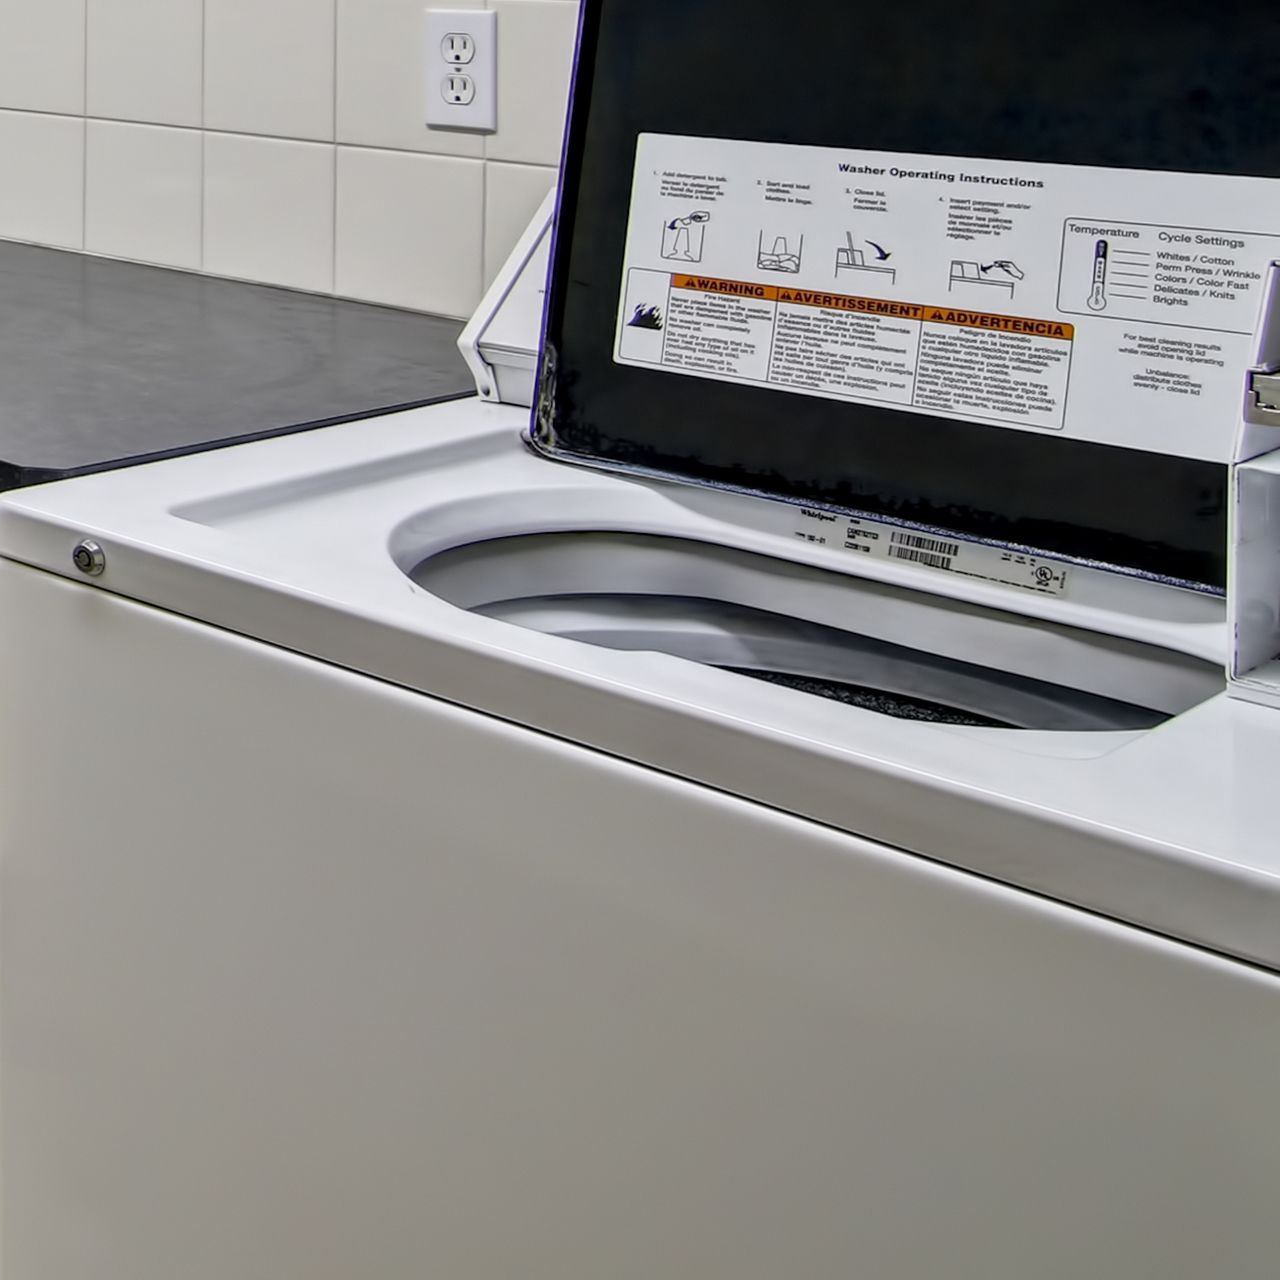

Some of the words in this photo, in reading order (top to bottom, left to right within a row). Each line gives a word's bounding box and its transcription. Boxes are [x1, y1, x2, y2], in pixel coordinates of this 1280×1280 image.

[838, 163, 886, 175] Washer
[889, 167, 955, 182] Operating
[959, 172, 1043, 188] Instructions
[1068, 223, 1139, 238] Temperature
[1158, 231, 1192, 243] Cycle
[1194, 234, 1244, 249] Settings
[1156, 251, 1190, 261] Whites
[1192, 254, 1198, 262] /
[1199, 255, 1234, 265] Cotton
[1155, 261, 1182, 272] Perm
[1184, 264, 1213, 275] Press
[1222, 268, 1260, 279] Wrinkle
[697, 279, 763, 296] WARNING
[1154, 272, 1187, 283] Colors
[1188, 276, 1194, 284] /
[1195, 277, 1224, 287] Color
[1226, 280, 1249, 289] Fast
[1152, 294, 1188, 306] Brights
[1153, 283, 1199, 296] Delicates
[1209, 289, 1235, 300] Knits
[793, 292, 920, 316] AVERTISSEMENT
[945, 311, 1063, 336] ADVERTENCIA
[1123, 332, 1137, 340] For
[1138, 335, 1156, 343] best
[1157, 338, 1192, 348] cleaning
[1193, 343, 1221, 351] results
[1139, 350, 1174, 359] machine
[1184, 356, 1224, 367] operating
[1160, 345, 1193, 356] opening
[1132, 373, 1170, 384] distribute
[1171, 379, 1202, 388] clothes
[1132, 381, 1159, 390] evenly
[1166, 385, 1188, 394] close
